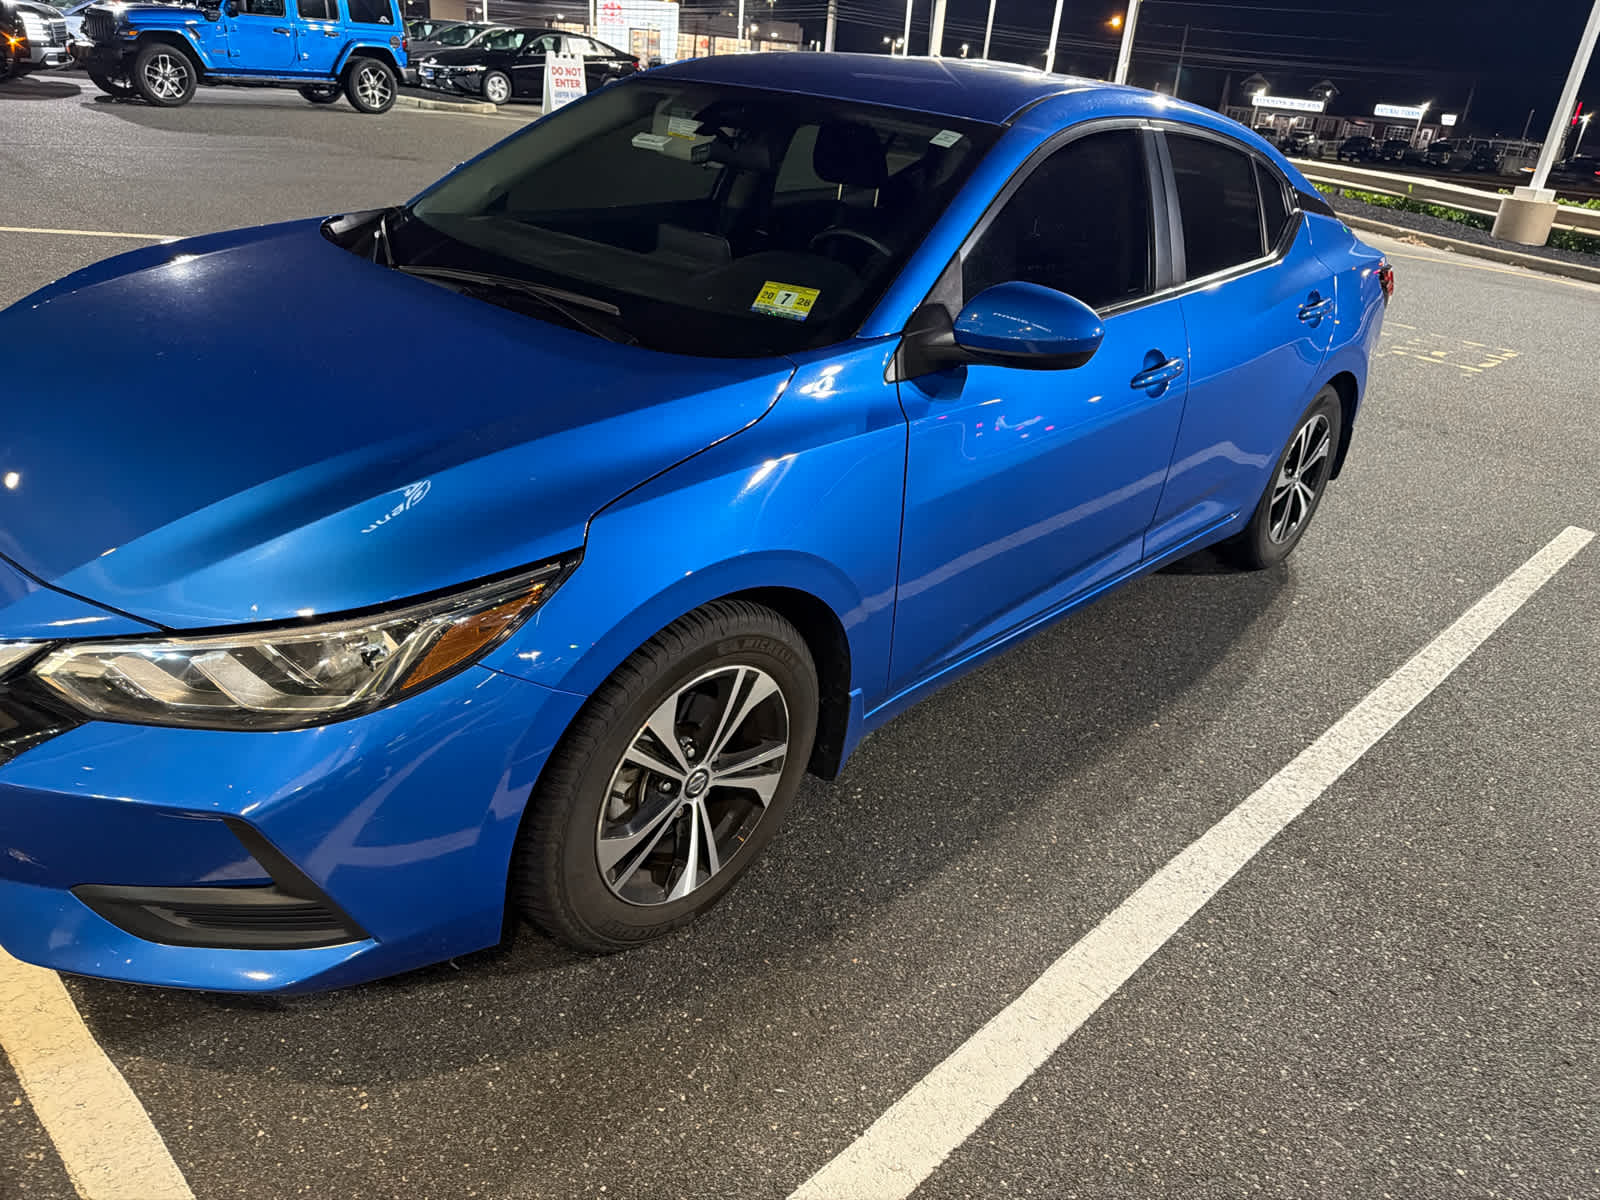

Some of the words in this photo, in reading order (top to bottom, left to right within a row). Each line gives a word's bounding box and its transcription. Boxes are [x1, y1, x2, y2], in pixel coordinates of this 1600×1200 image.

[551, 66, 563, 76] DO
[564, 67, 582, 77] NOT
[555, 78, 581, 88] ENTER
[760, 290, 775, 299] 20
[780, 293, 792, 304] 7
